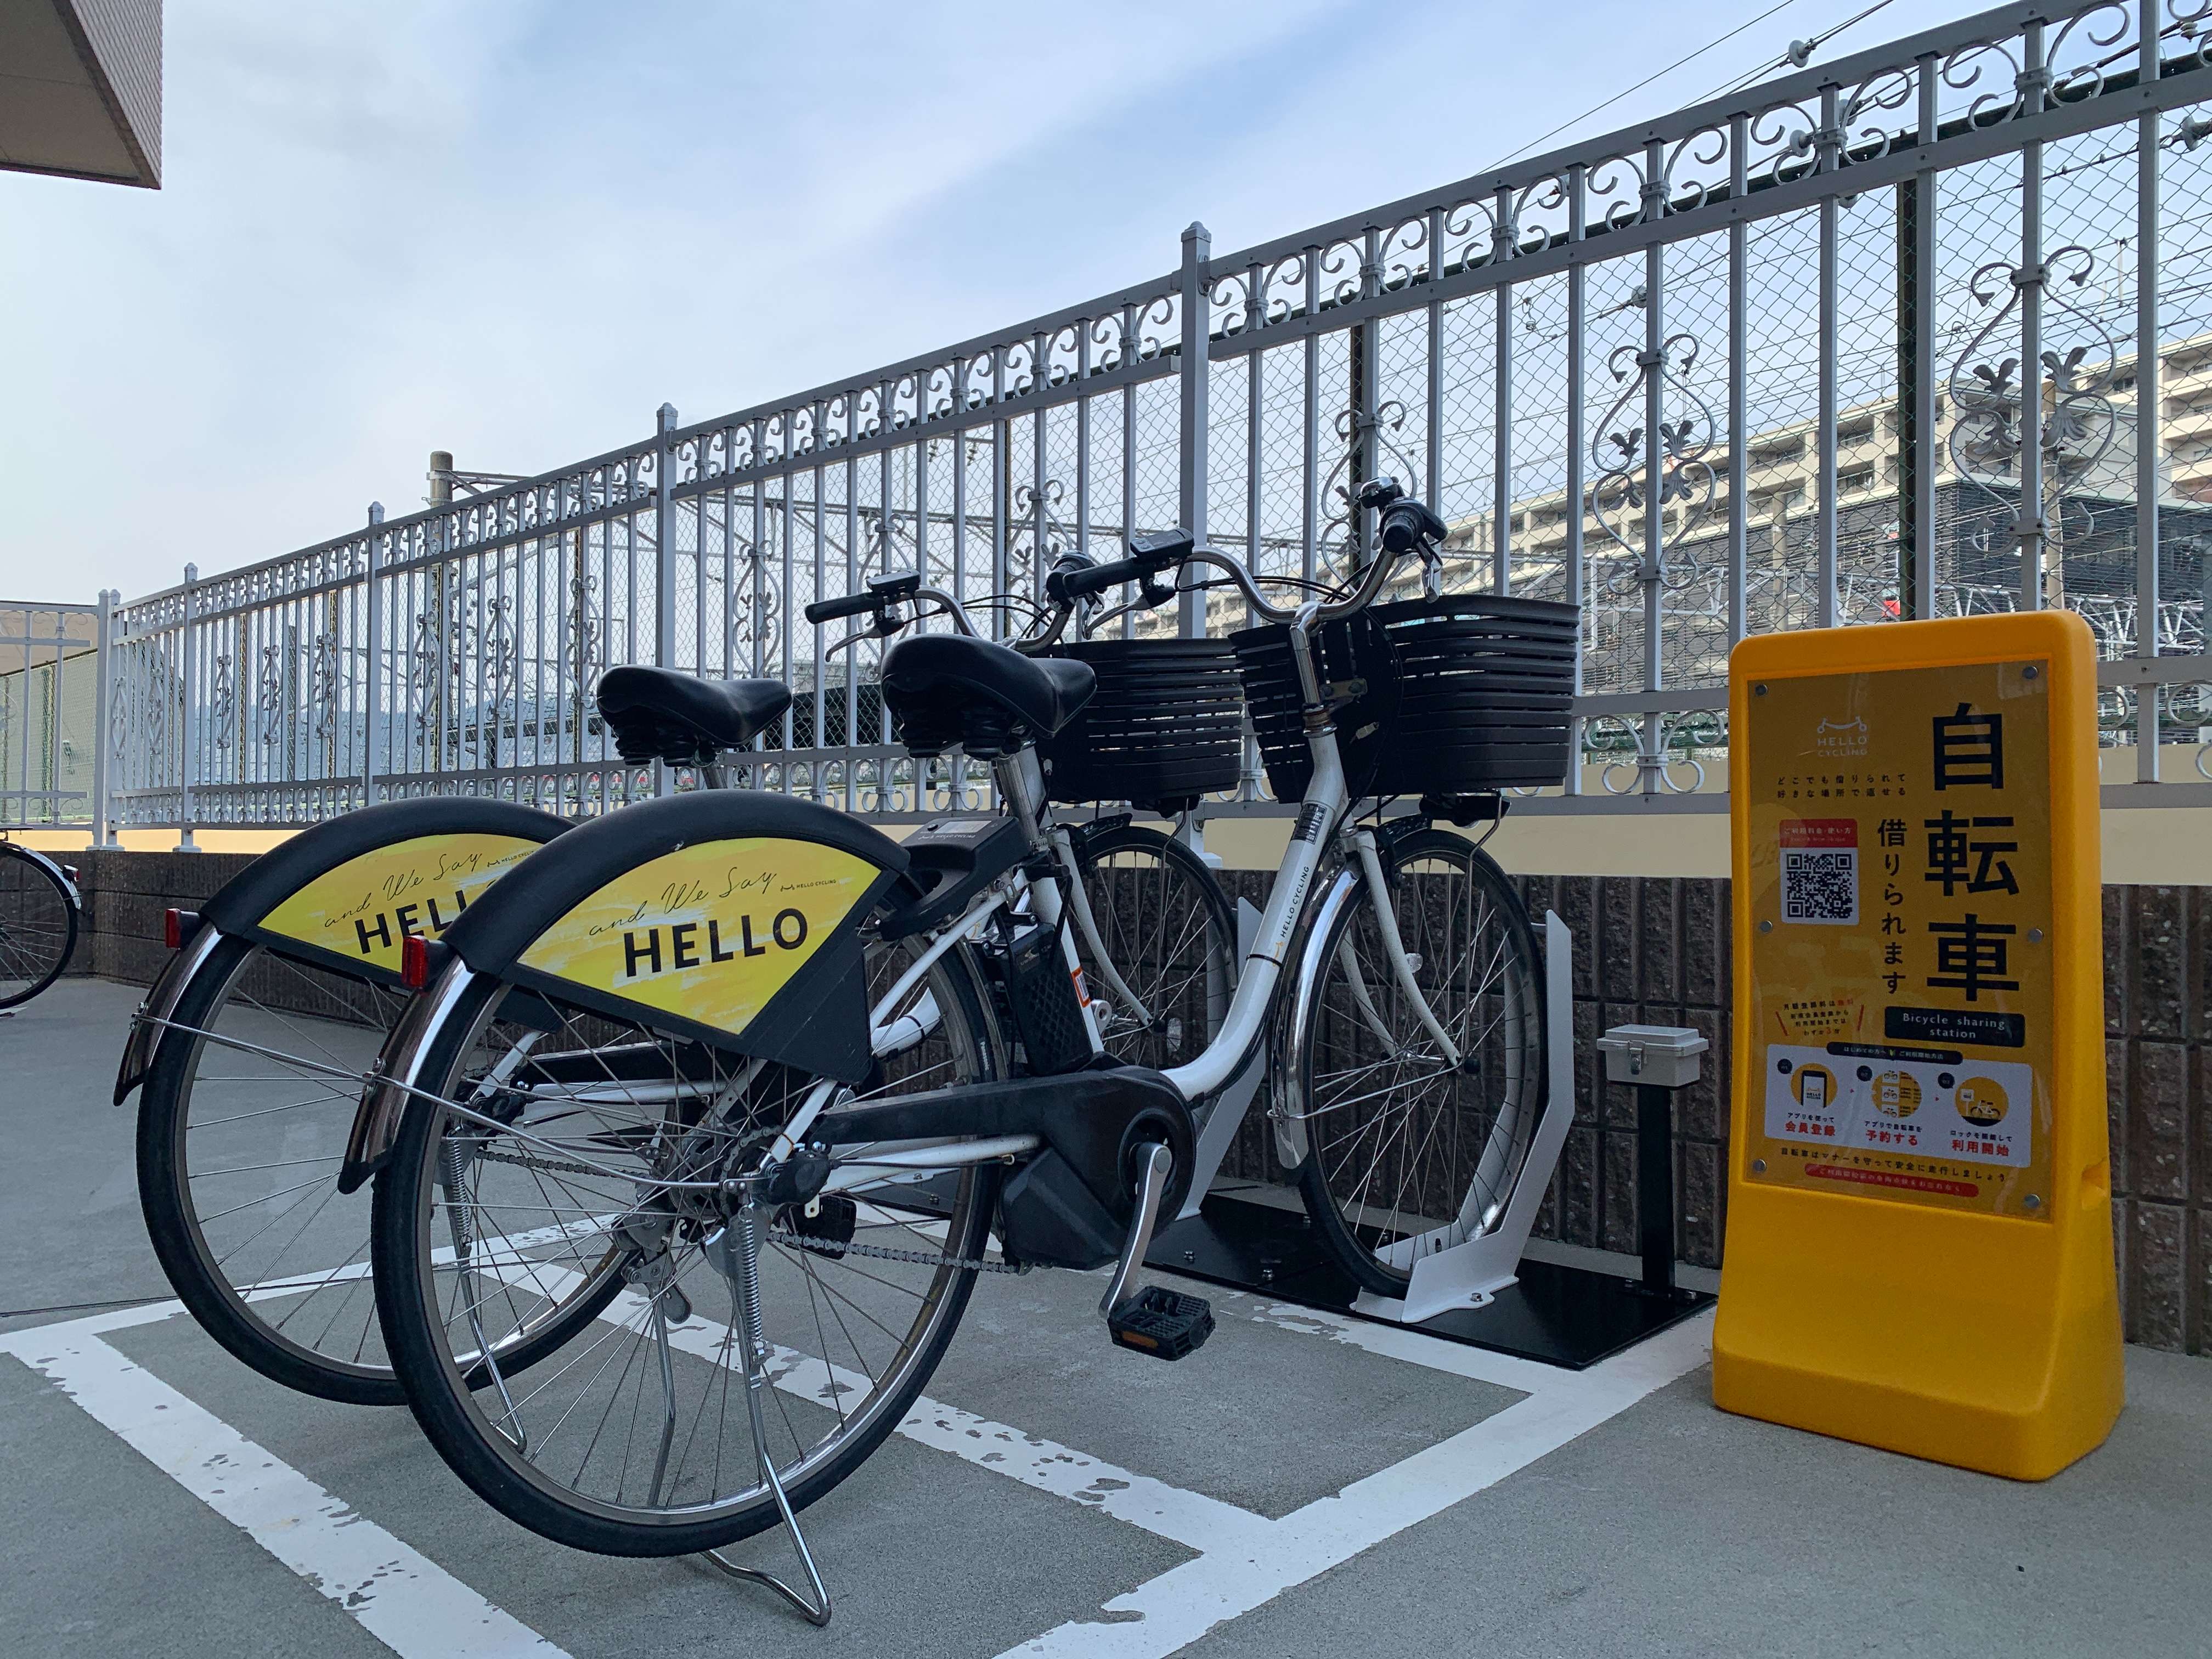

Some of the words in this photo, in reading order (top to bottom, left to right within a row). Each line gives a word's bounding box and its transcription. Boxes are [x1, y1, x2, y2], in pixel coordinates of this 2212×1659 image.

[1817, 736, 1867, 746] HELLO
[1778, 774, 1906, 785] どこでも借りられて
[1777, 787, 1906, 798] 好きな場所で返せる
[1924, 702, 2019, 1002] 自転車
[325, 893, 371, 928] and
[383, 869, 424, 901] We
[433, 853, 483, 881] Say
[589, 900, 645, 936] and
[661, 879, 709, 915] We
[719, 866, 777, 898] Say
[1280, 907, 1295, 938] HELLO
[1293, 866, 1310, 905] CYCLING
[1877, 819, 1908, 994] 借りられます
[624, 908, 809, 978] HELLO
[1903, 1013, 1949, 1025] Bicycle
[1957, 1016, 2005, 1031] sharing
[1929, 1029, 1976, 1039] station
[1785, 1120, 1836, 1137] 会員登録
[1866, 1129, 1918, 1146] 予約する
[1952, 1139, 2010, 1156] 利用開始
